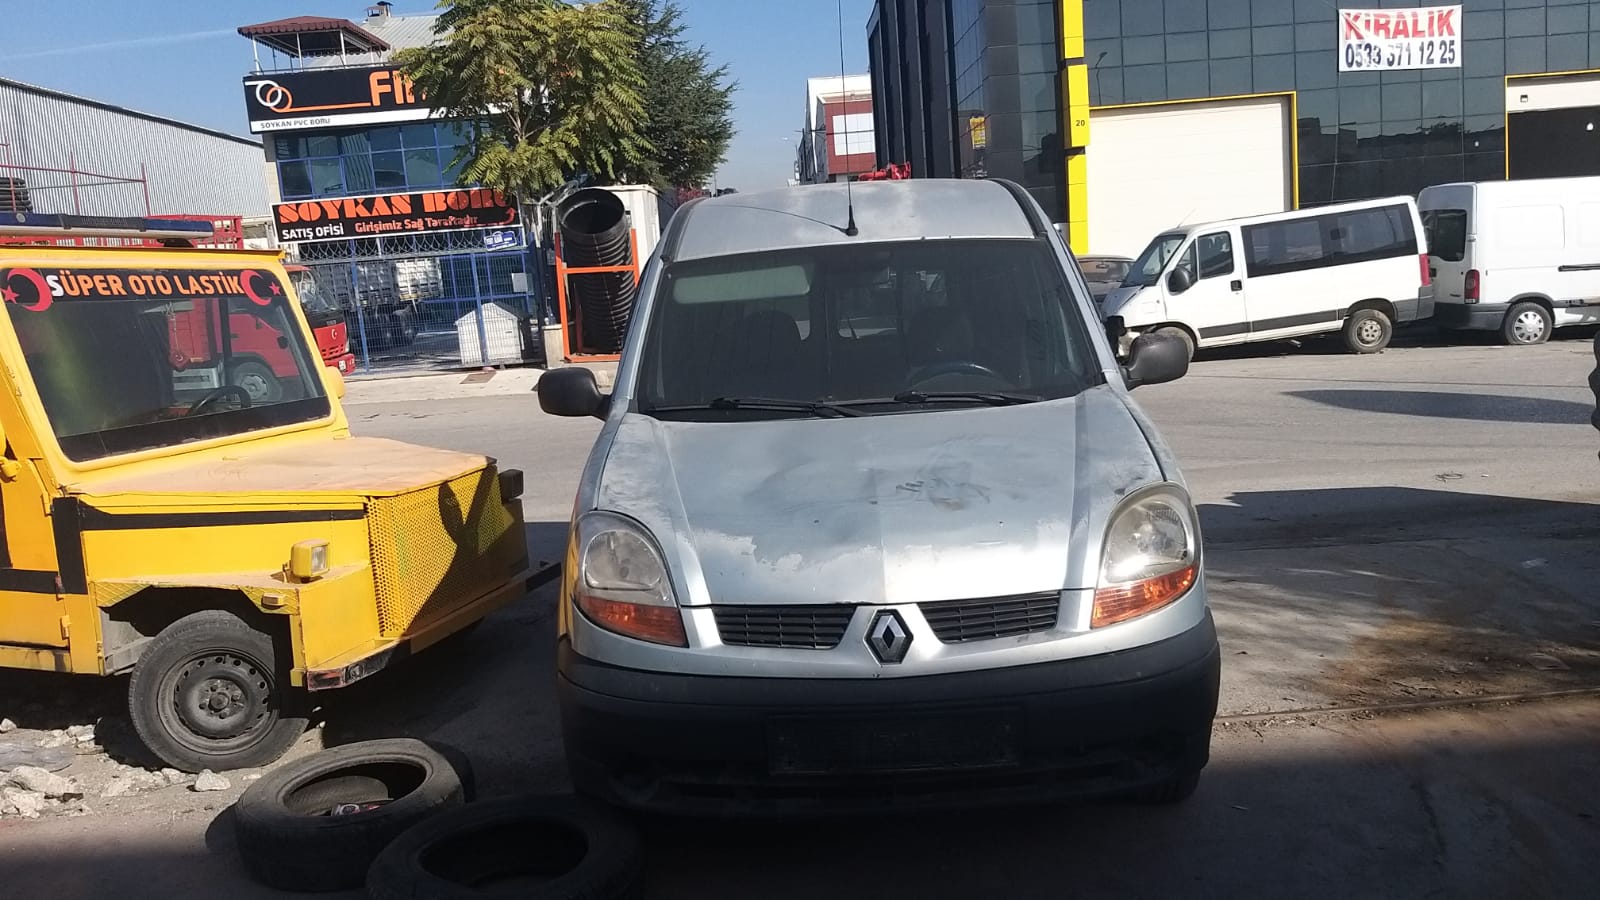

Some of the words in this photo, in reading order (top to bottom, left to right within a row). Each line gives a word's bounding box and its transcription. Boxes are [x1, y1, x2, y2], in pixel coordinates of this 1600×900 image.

[1419, 40, 1435, 65] 12
[1439, 39, 1456, 64] 25
[260, 120, 292, 129] SOYKAN
[1075, 119, 1086, 127] 20
[278, 194, 412, 224] SOYKAN
[282, 227, 314, 240] SATIŞ
[315, 222, 345, 237] OFİSİ
[355, 219, 402, 233] Girişimiz
[403, 218, 425, 231] Sağ
[45, 270, 127, 297] SÜPER
[128, 274, 173, 296] OTO
[173, 271, 245, 295] LASTİK
